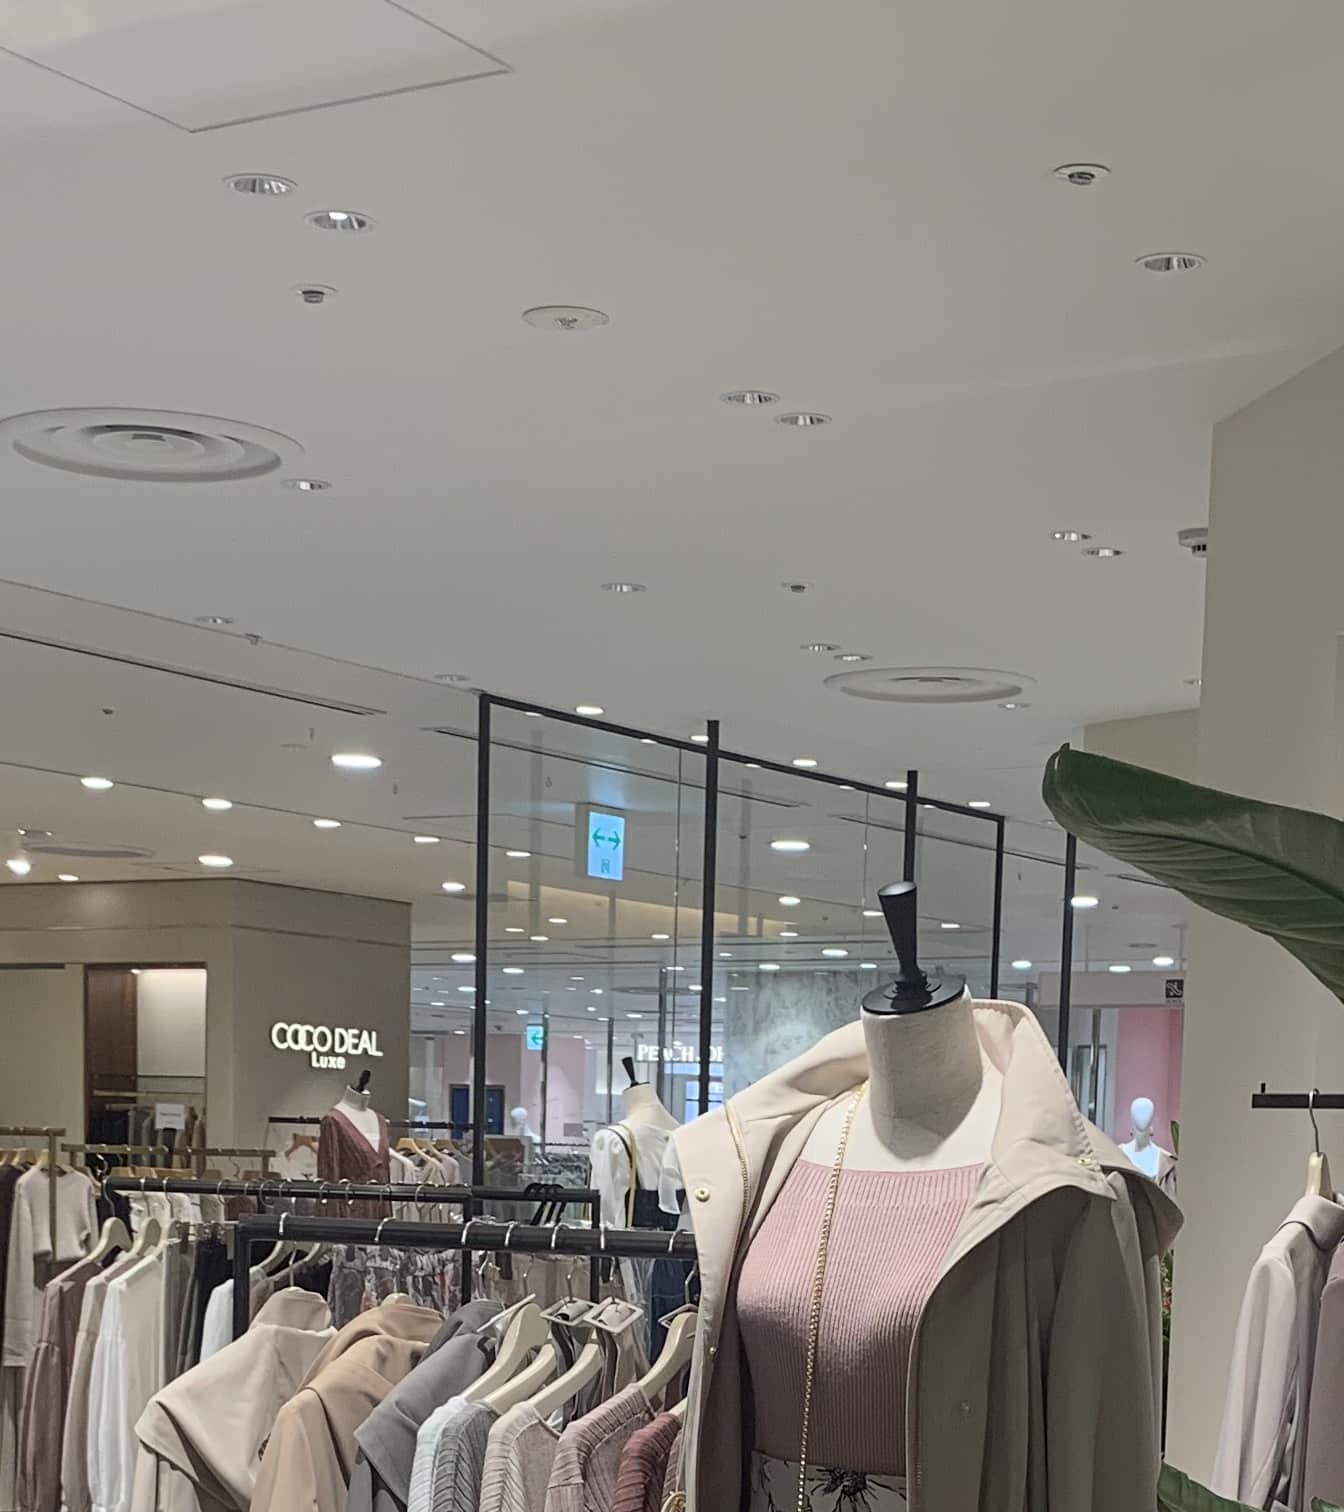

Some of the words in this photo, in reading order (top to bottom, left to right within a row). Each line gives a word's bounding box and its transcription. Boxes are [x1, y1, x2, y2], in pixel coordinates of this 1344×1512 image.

[271, 1022, 332, 1052] COCO
[334, 1027, 383, 1056] DEAL
[311, 1051, 346, 1069] Luxe
